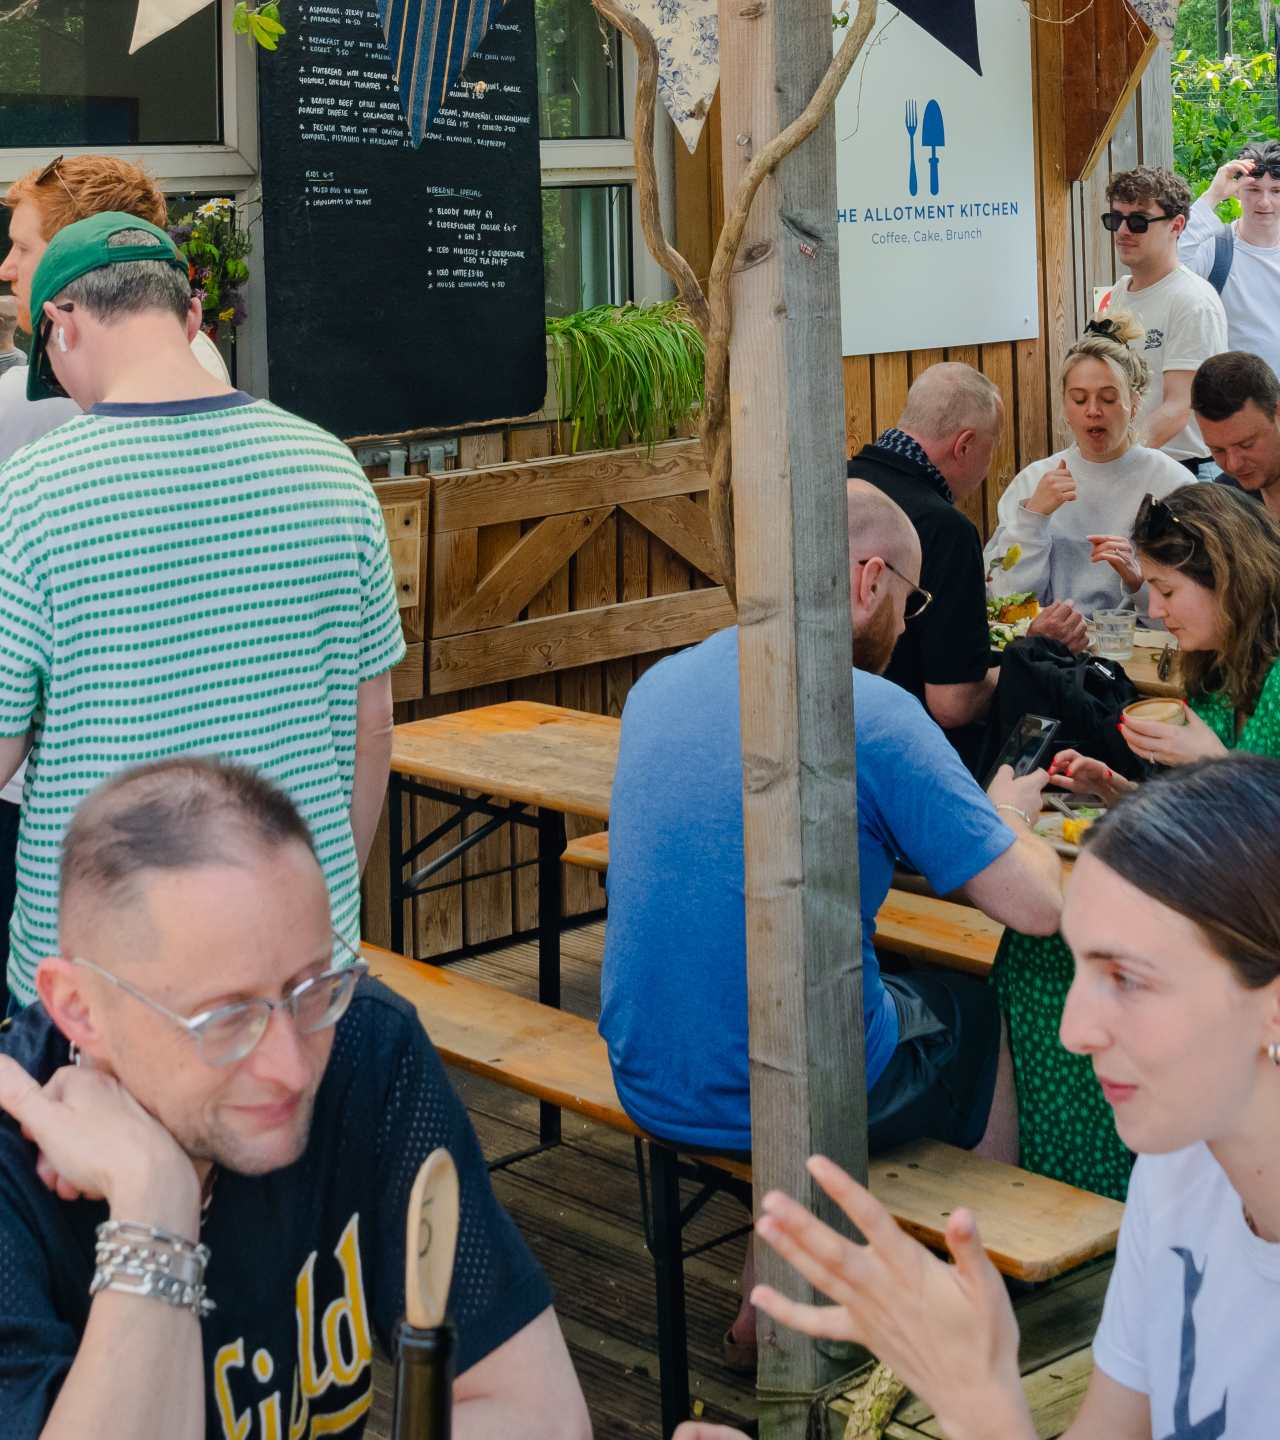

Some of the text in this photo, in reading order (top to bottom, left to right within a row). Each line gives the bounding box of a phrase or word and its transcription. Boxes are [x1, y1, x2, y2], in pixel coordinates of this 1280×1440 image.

[308, 36, 340, 46] BREAKFAST
[359, 41, 373, 49] WITH
[338, 98, 354, 107] BEEF
[312, 123, 336, 132] FRENCH
[436, 207, 460, 217] BLOODY
[463, 208, 482, 219] MARY
[836, 201, 1019, 223] HE ALLOTMENT KITCHEN
[436, 220, 476, 231] ELDERFLOWER
[871, 227, 983, 246] Coffee, Cake, Brunch
